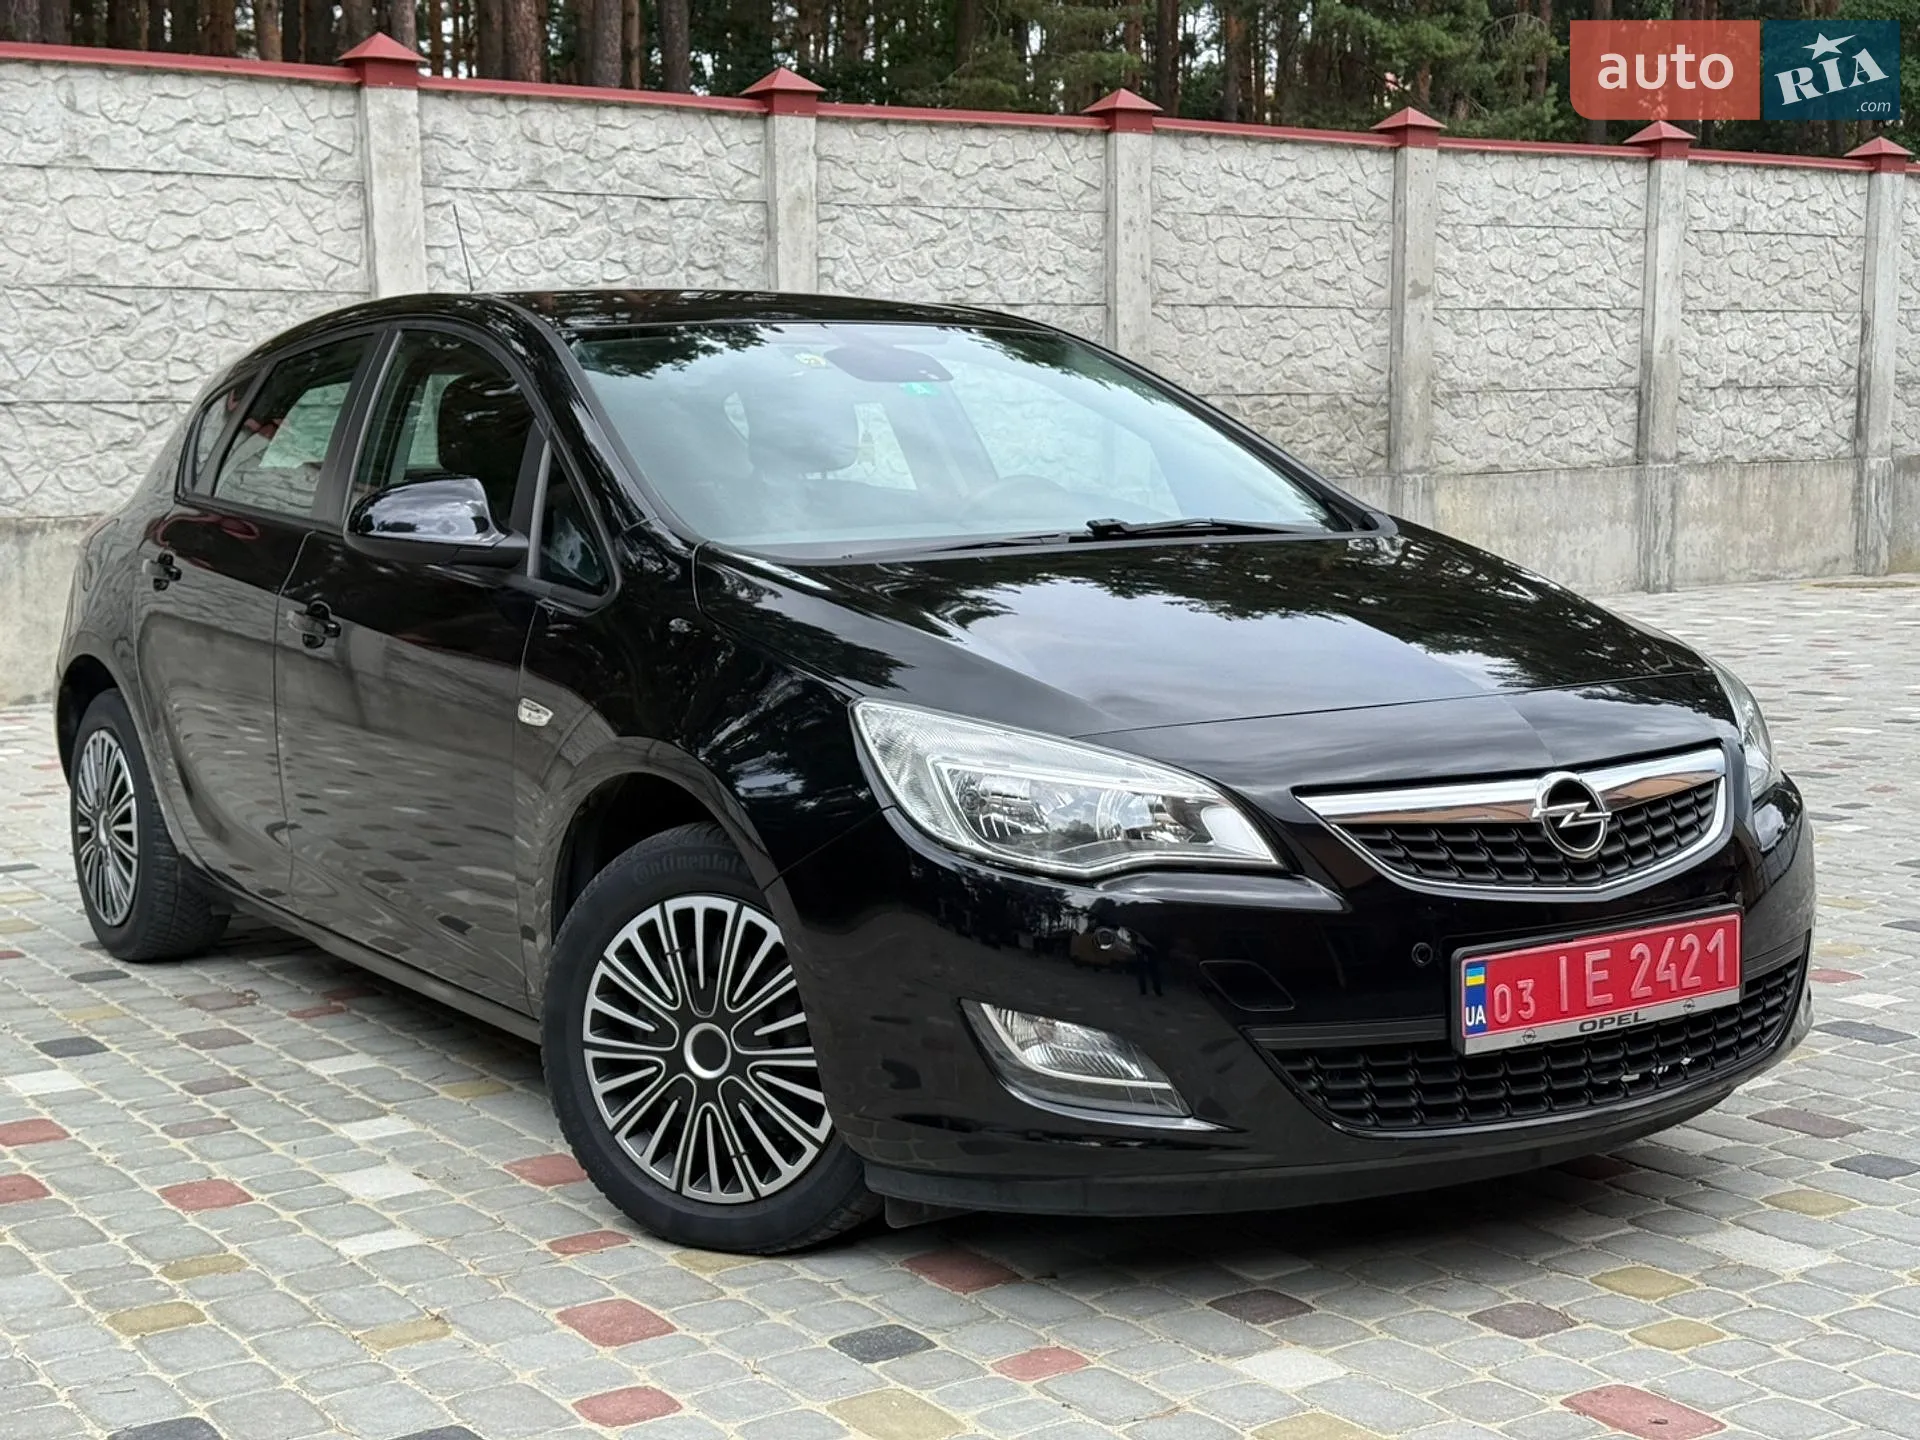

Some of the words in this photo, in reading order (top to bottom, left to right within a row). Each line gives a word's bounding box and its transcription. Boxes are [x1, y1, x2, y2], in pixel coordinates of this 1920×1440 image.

[1493, 978, 1536, 1024] 03
[1559, 949, 1614, 1012] IE
[1629, 927, 1726, 1000] 2421
[1465, 1005, 1487, 1027] UA
[1578, 1011, 1647, 1033] OPEL
